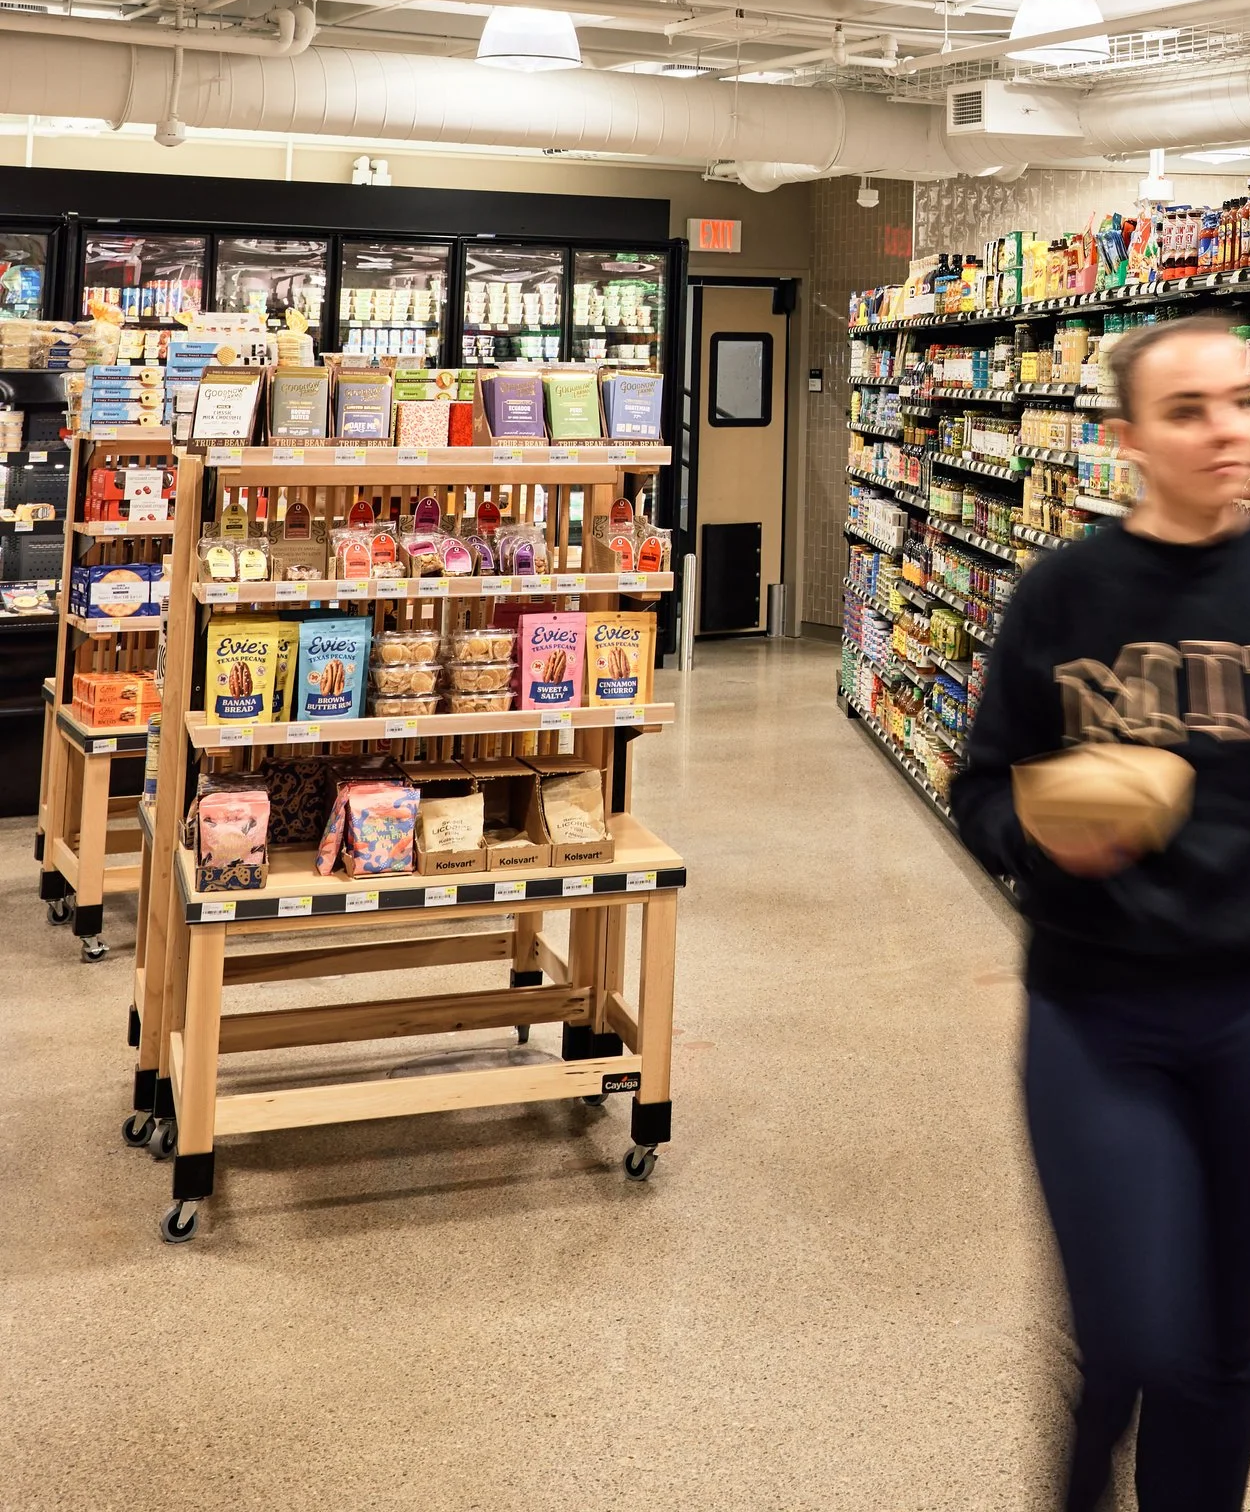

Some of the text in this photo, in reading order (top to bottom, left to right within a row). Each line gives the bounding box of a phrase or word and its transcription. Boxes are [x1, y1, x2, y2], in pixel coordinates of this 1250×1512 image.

[700, 220, 734, 249] EXIT
[195, 439, 245, 447] TRUE BEAN
[275, 439, 325, 447] TRUE BEAN
[497, 439, 544, 447] TRUE BEAN
[531, 626, 577, 645] Evie's
[594, 624, 641, 642] Evie's
[217, 638, 268, 656] Evie's
[308, 636, 357, 655] Evie's
[532, 644, 552, 652] TEXAS
[217, 655, 266, 665] TEXAS PECANS
[309, 653, 356, 663] TEXAS PECANS
[599, 680, 637, 688] CINNAMON
[318, 696, 345, 704] BROWN
[307, 701, 352, 711] BUTTER RUM
[605, 1079, 638, 1090] Cayuga
